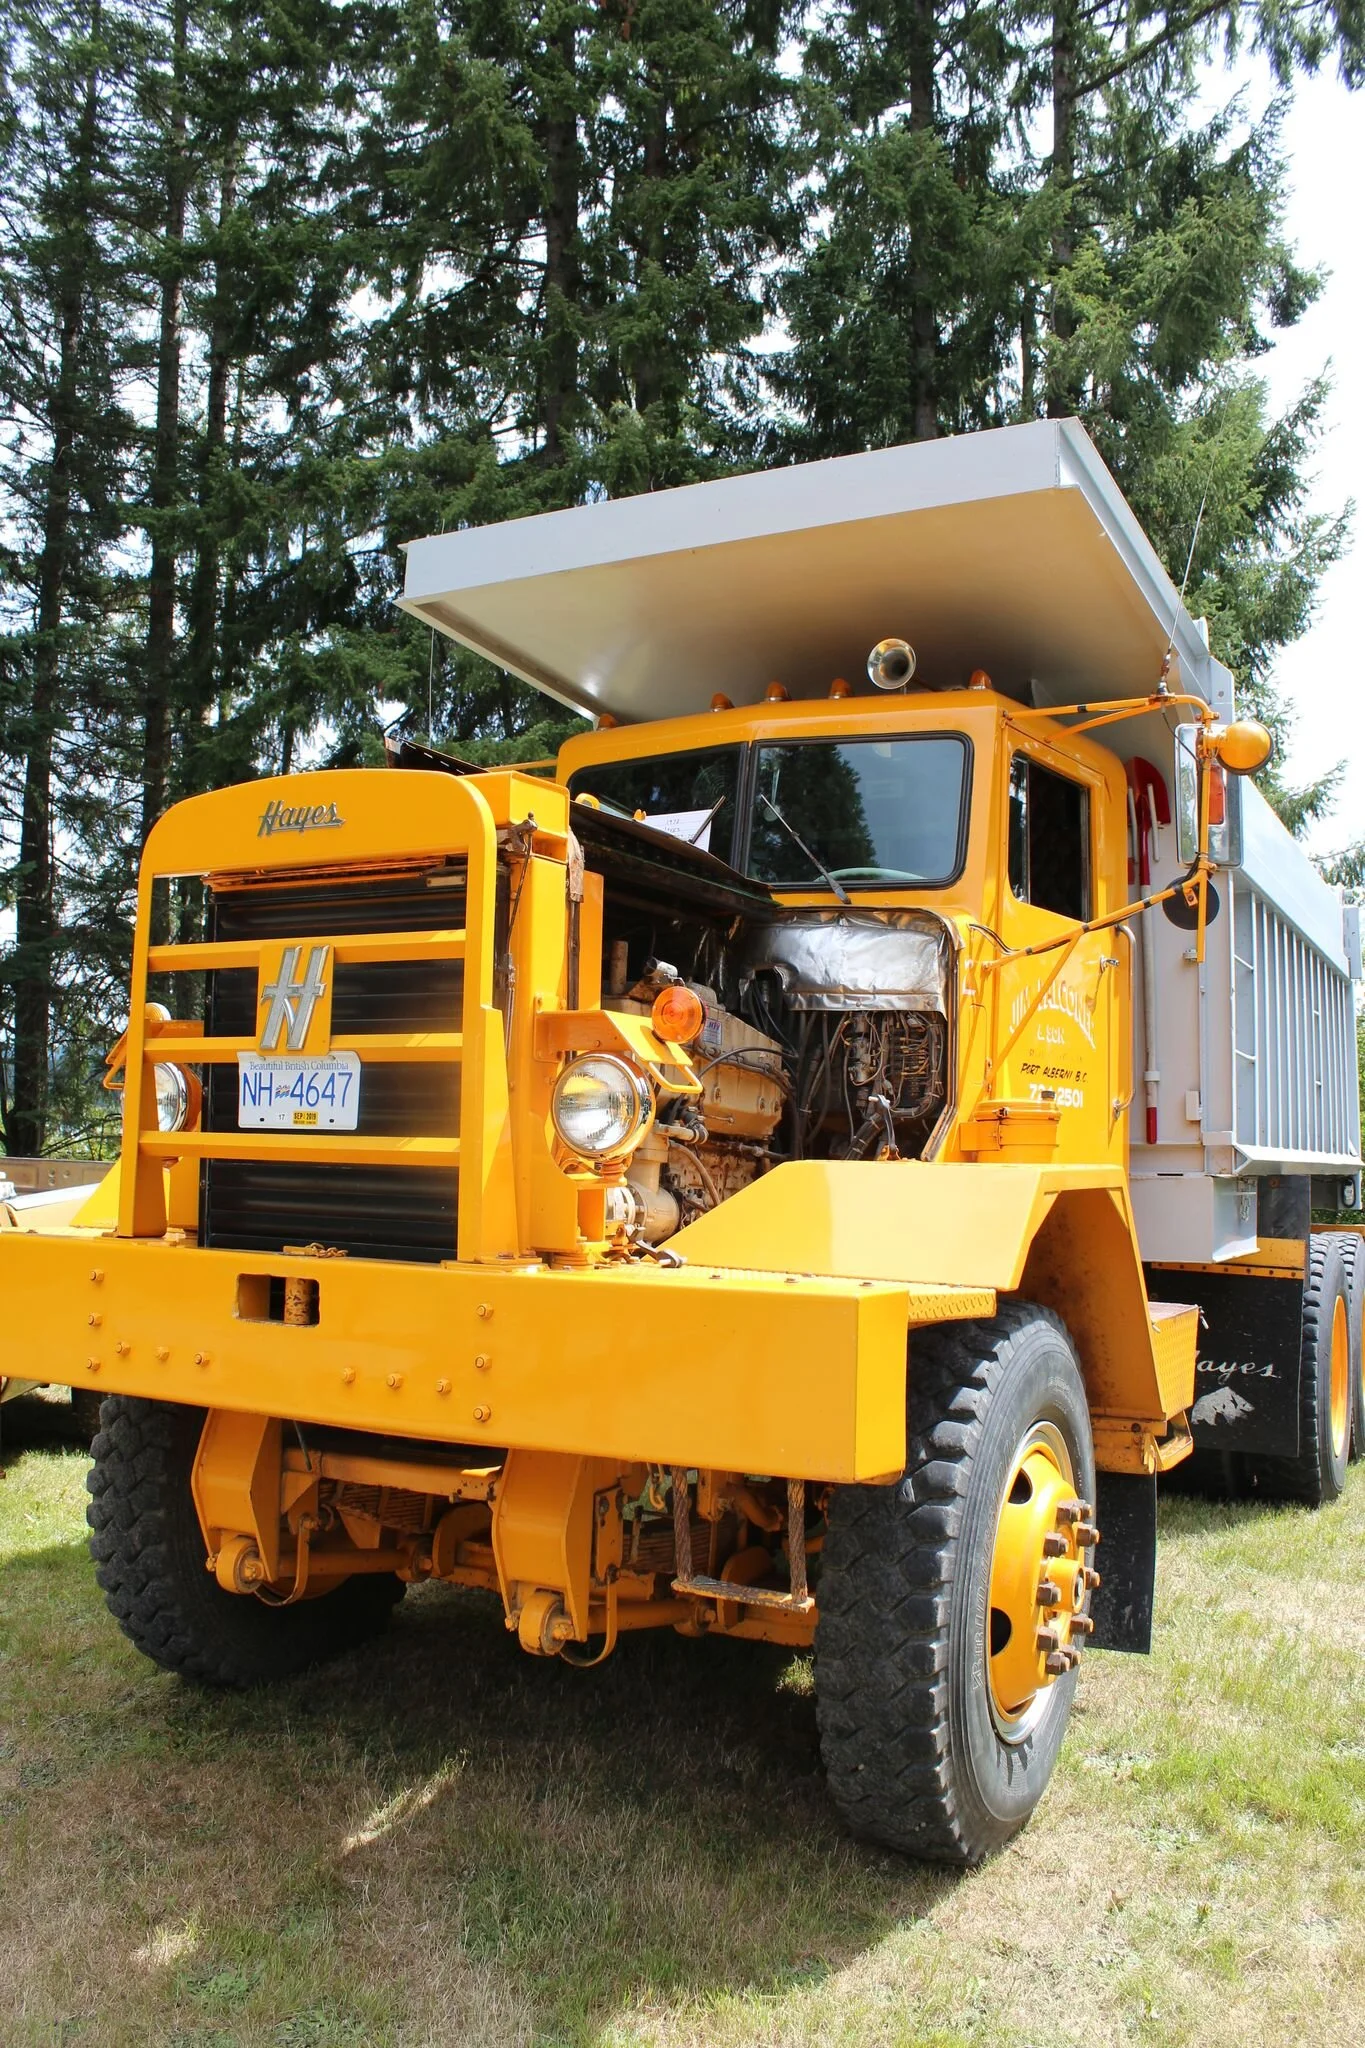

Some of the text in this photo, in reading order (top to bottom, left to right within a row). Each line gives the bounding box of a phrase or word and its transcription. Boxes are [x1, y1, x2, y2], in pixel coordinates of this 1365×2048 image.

[257, 799, 346, 837] Hayes
[250, 1060, 349, 1071] Beautiful British Columbia
[1020, 1062, 1041, 1076] PORT
[1043, 1066, 1073, 1079] ALBERNI
[242, 1072, 353, 1107] NH 4647
[294, 1112, 303, 1120] SEP
[1195, 1350, 1281, 1385] ayes
